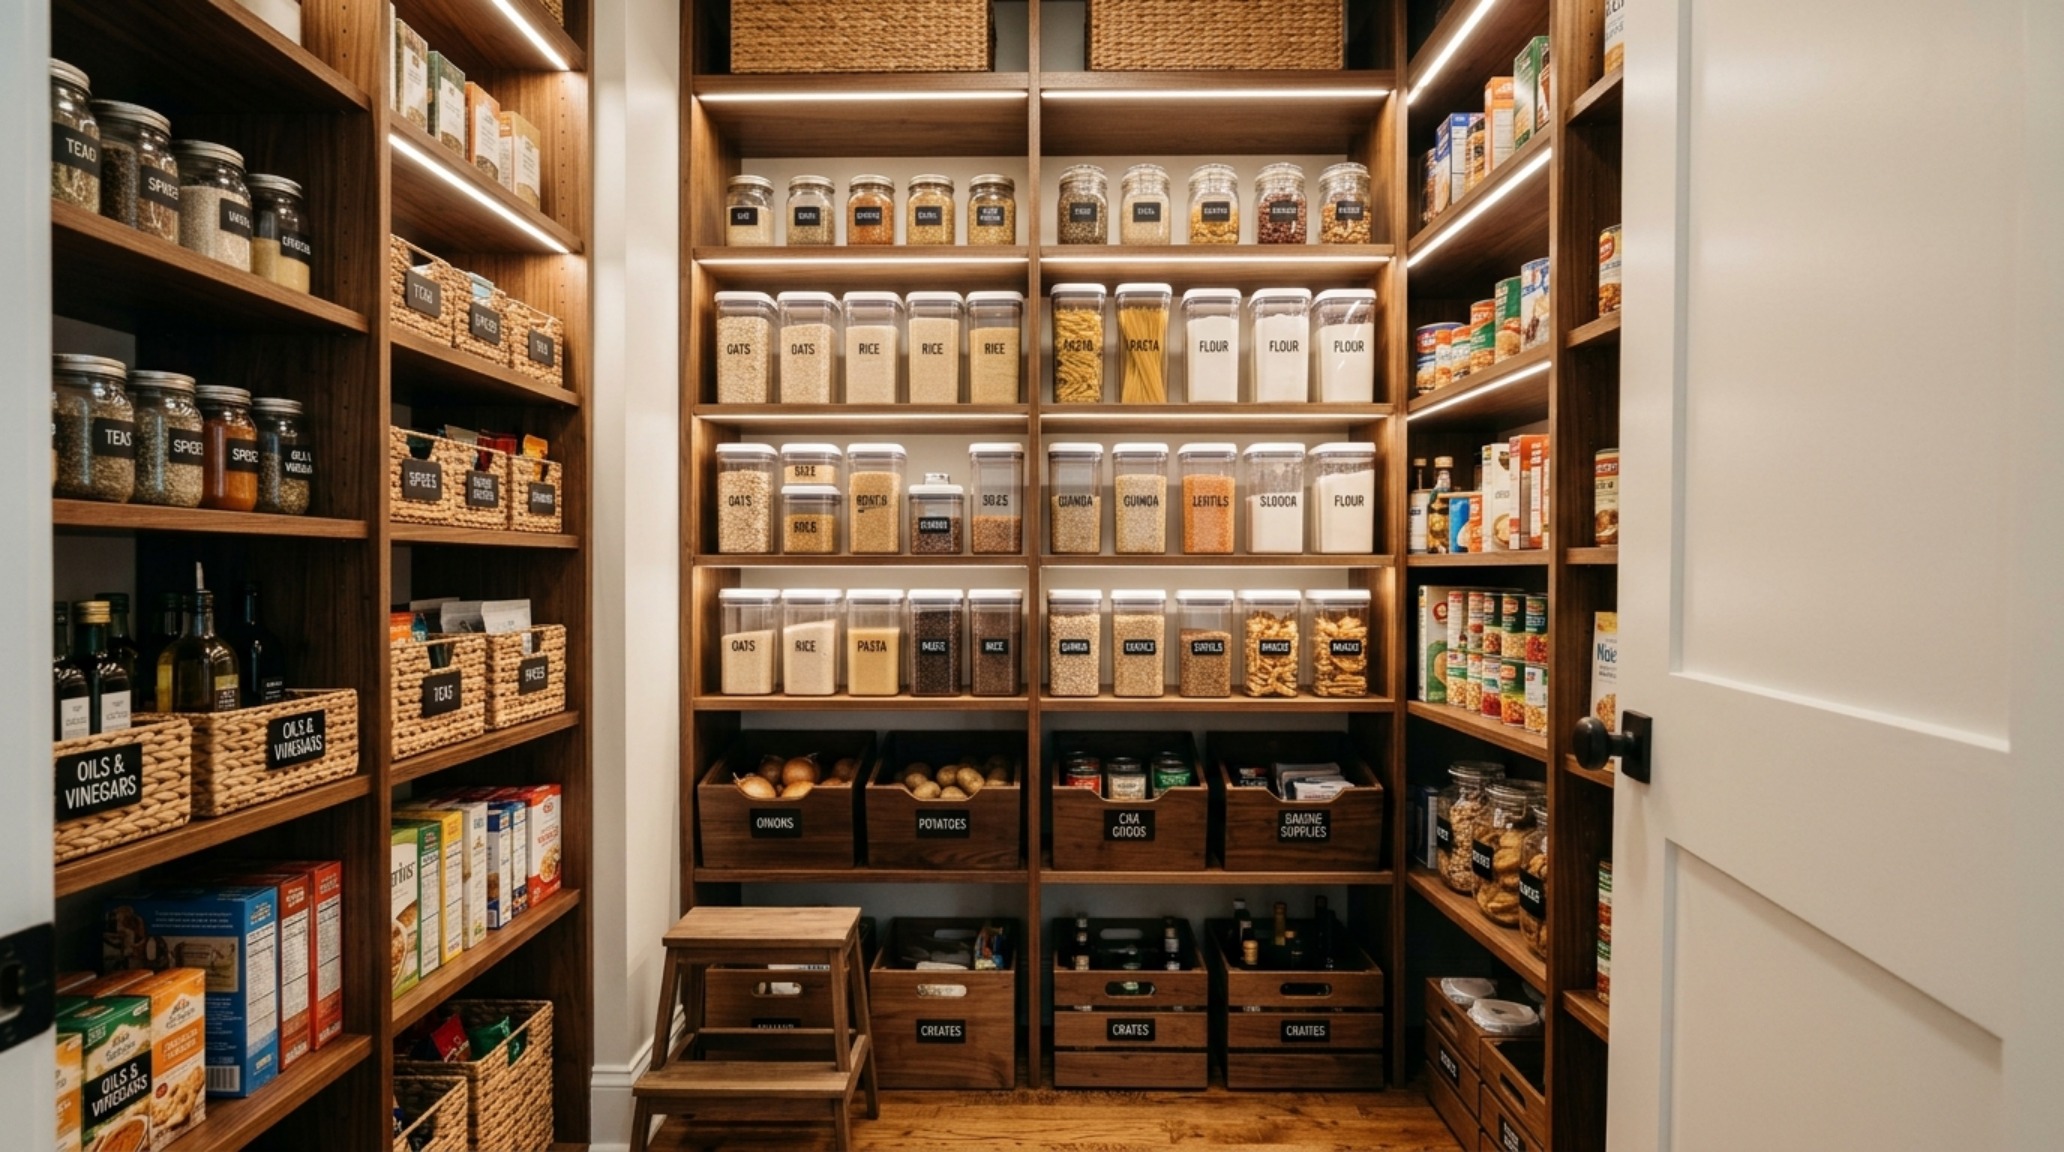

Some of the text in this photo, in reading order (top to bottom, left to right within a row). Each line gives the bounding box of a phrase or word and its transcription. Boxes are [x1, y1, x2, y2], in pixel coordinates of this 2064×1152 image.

[726, 343, 751, 355] OATS
[791, 343, 815, 355] OATS
[858, 343, 880, 355] RICE
[921, 343, 944, 355] RICE
[1199, 340, 1229, 353] FLOUR
[1269, 340, 1300, 353] FLOUR
[104, 428, 132, 447] TEAS
[728, 495, 752, 507] OATS
[1335, 494, 1364, 507] FLOUR
[730, 640, 755, 653] OATS
[794, 640, 816, 653] RICE
[857, 640, 887, 653] PASTA
[77, 753, 125, 783] OILS &
[65, 774, 136, 810] VINEGARS
[918, 818, 966, 831] POTATOES
[1112, 1024, 1149, 1036] CRATES
